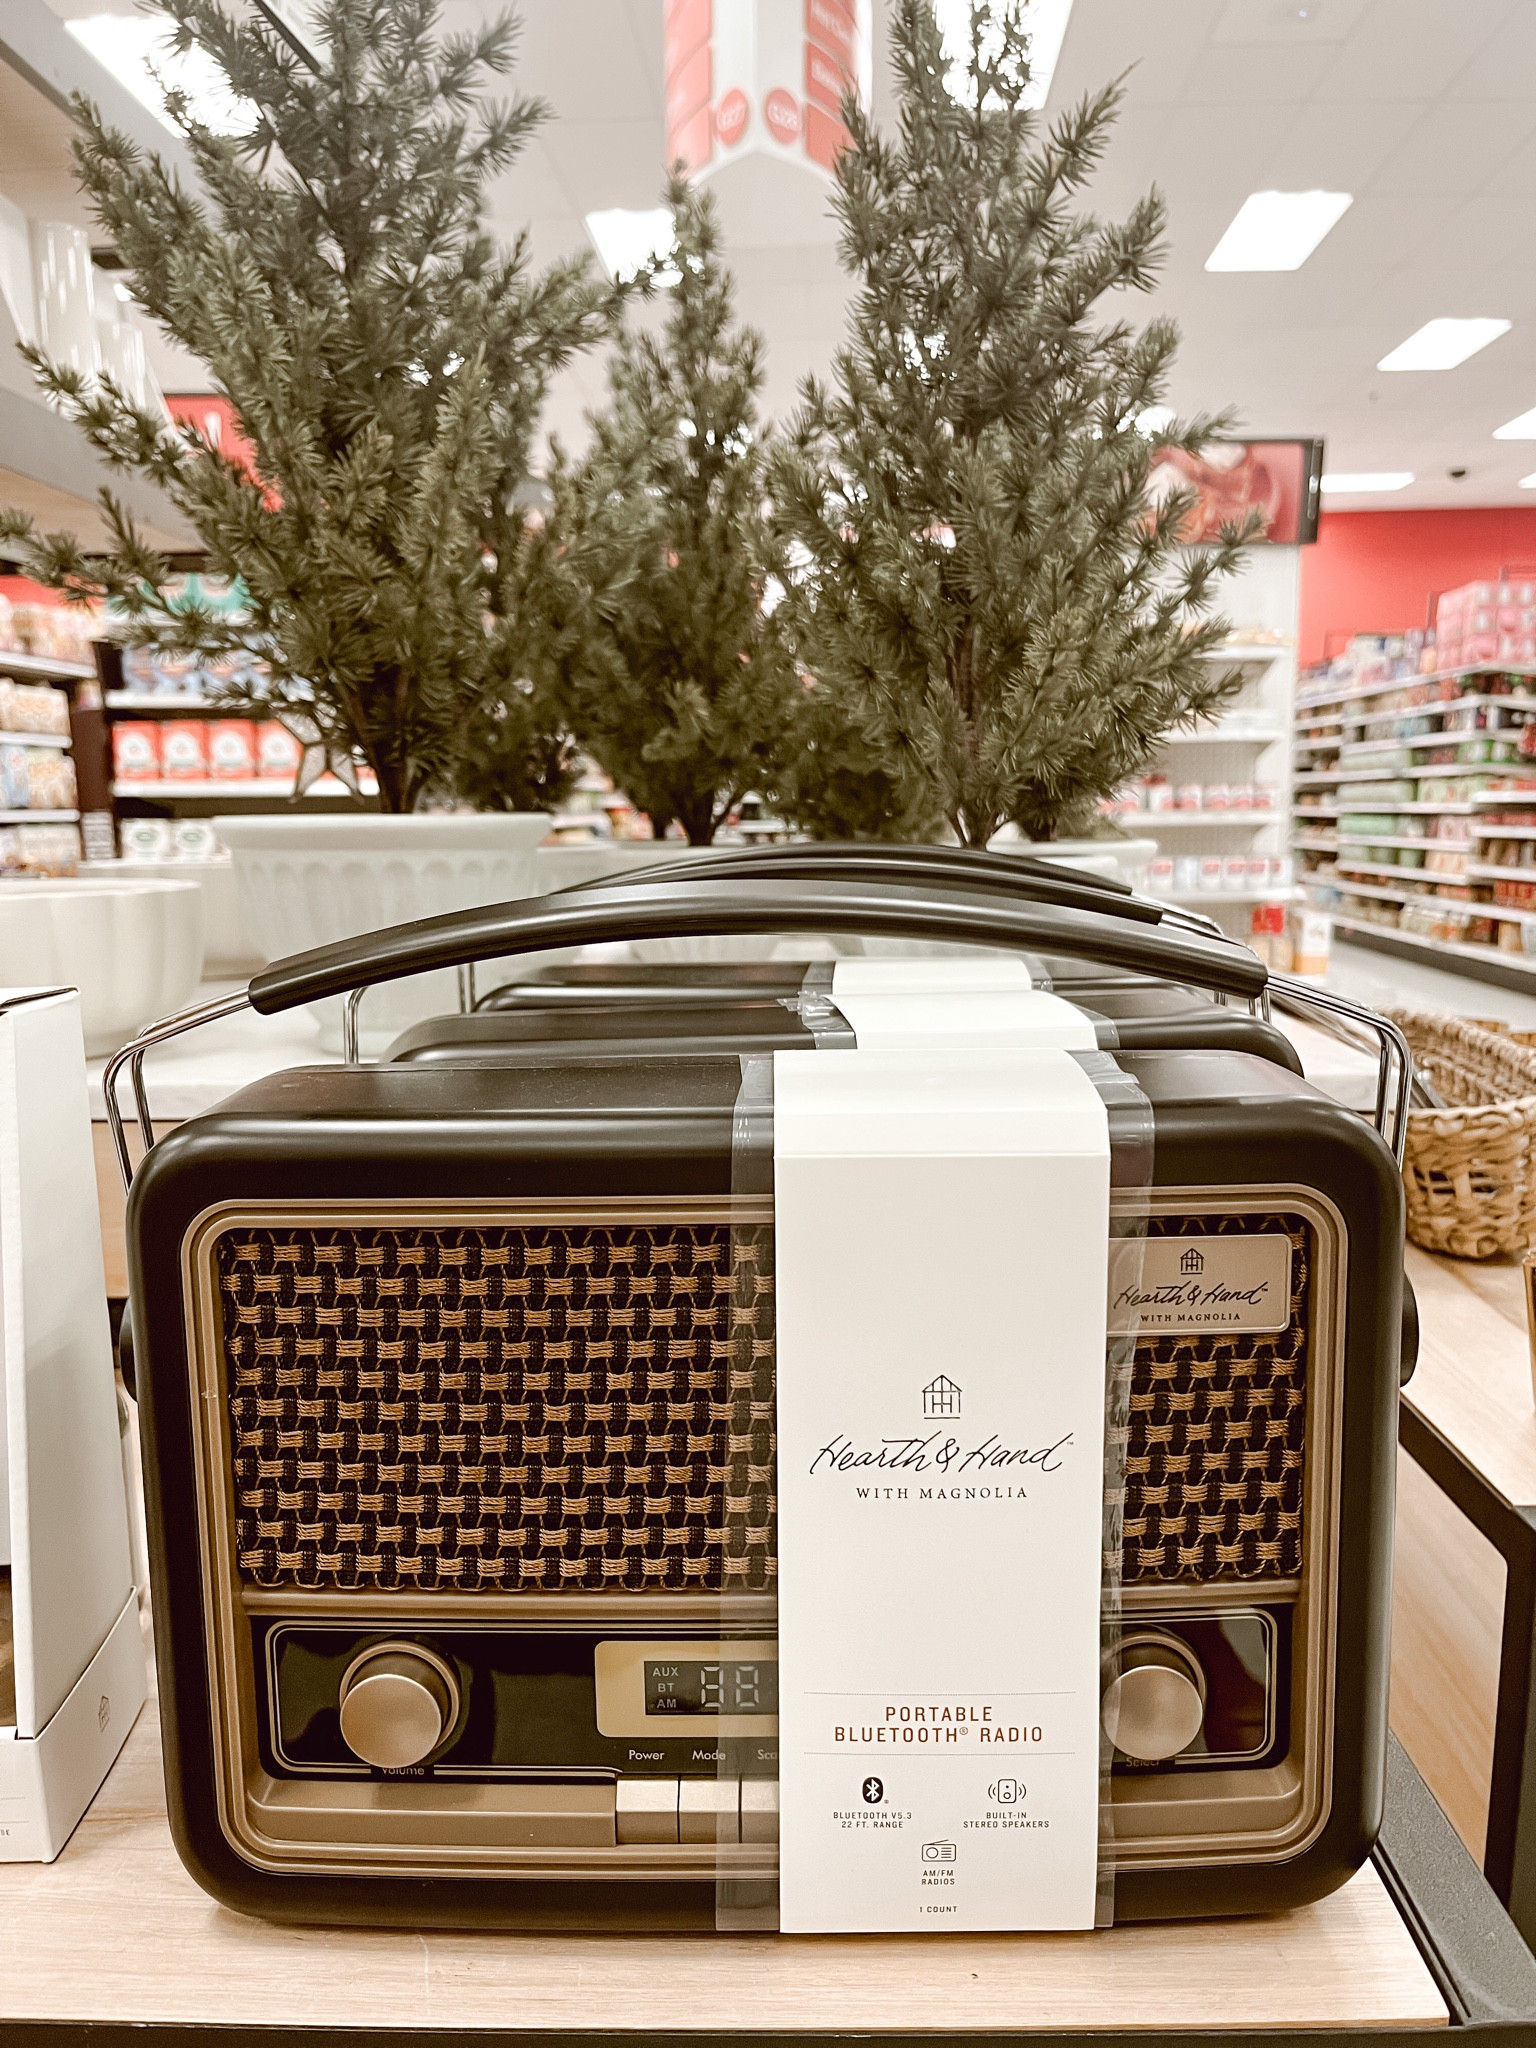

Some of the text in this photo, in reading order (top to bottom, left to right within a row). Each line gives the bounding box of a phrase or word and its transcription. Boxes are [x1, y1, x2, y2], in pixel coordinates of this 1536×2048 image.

[1113, 1280, 1191, 1309] Hearth
[1187, 1284, 1203, 1307] &
[1140, 1312, 1241, 1323] WITH MAGNOLIA
[809, 1430, 942, 1475] Hearth
[935, 1438, 960, 1474] &
[856, 1486, 1028, 1500] WITH MAGNOLIA
[652, 1667, 679, 1677] AUX
[657, 1683, 675, 1693] BT
[656, 1698, 677, 1709] AM
[885, 1706, 993, 1722] PORTABLE
[980, 1726, 1043, 1743] RADIO
[628, 1749, 665, 1761] Power
[691, 1749, 726, 1761] Mode
[757, 1748, 778, 1760] Sca
[833, 1811, 912, 1820] BLUETOOTH V5.3
[986, 1811, 1027, 1819] BUILT-IN
[841, 1820, 904, 1829] 22 FT. RANGE
[963, 1820, 1050, 1829] STEREO SPEAKERS
[922, 1869, 954, 1877] AM/FM
[921, 1878, 956, 1886] RADIOS
[926, 1905, 958, 1913] COUNT
